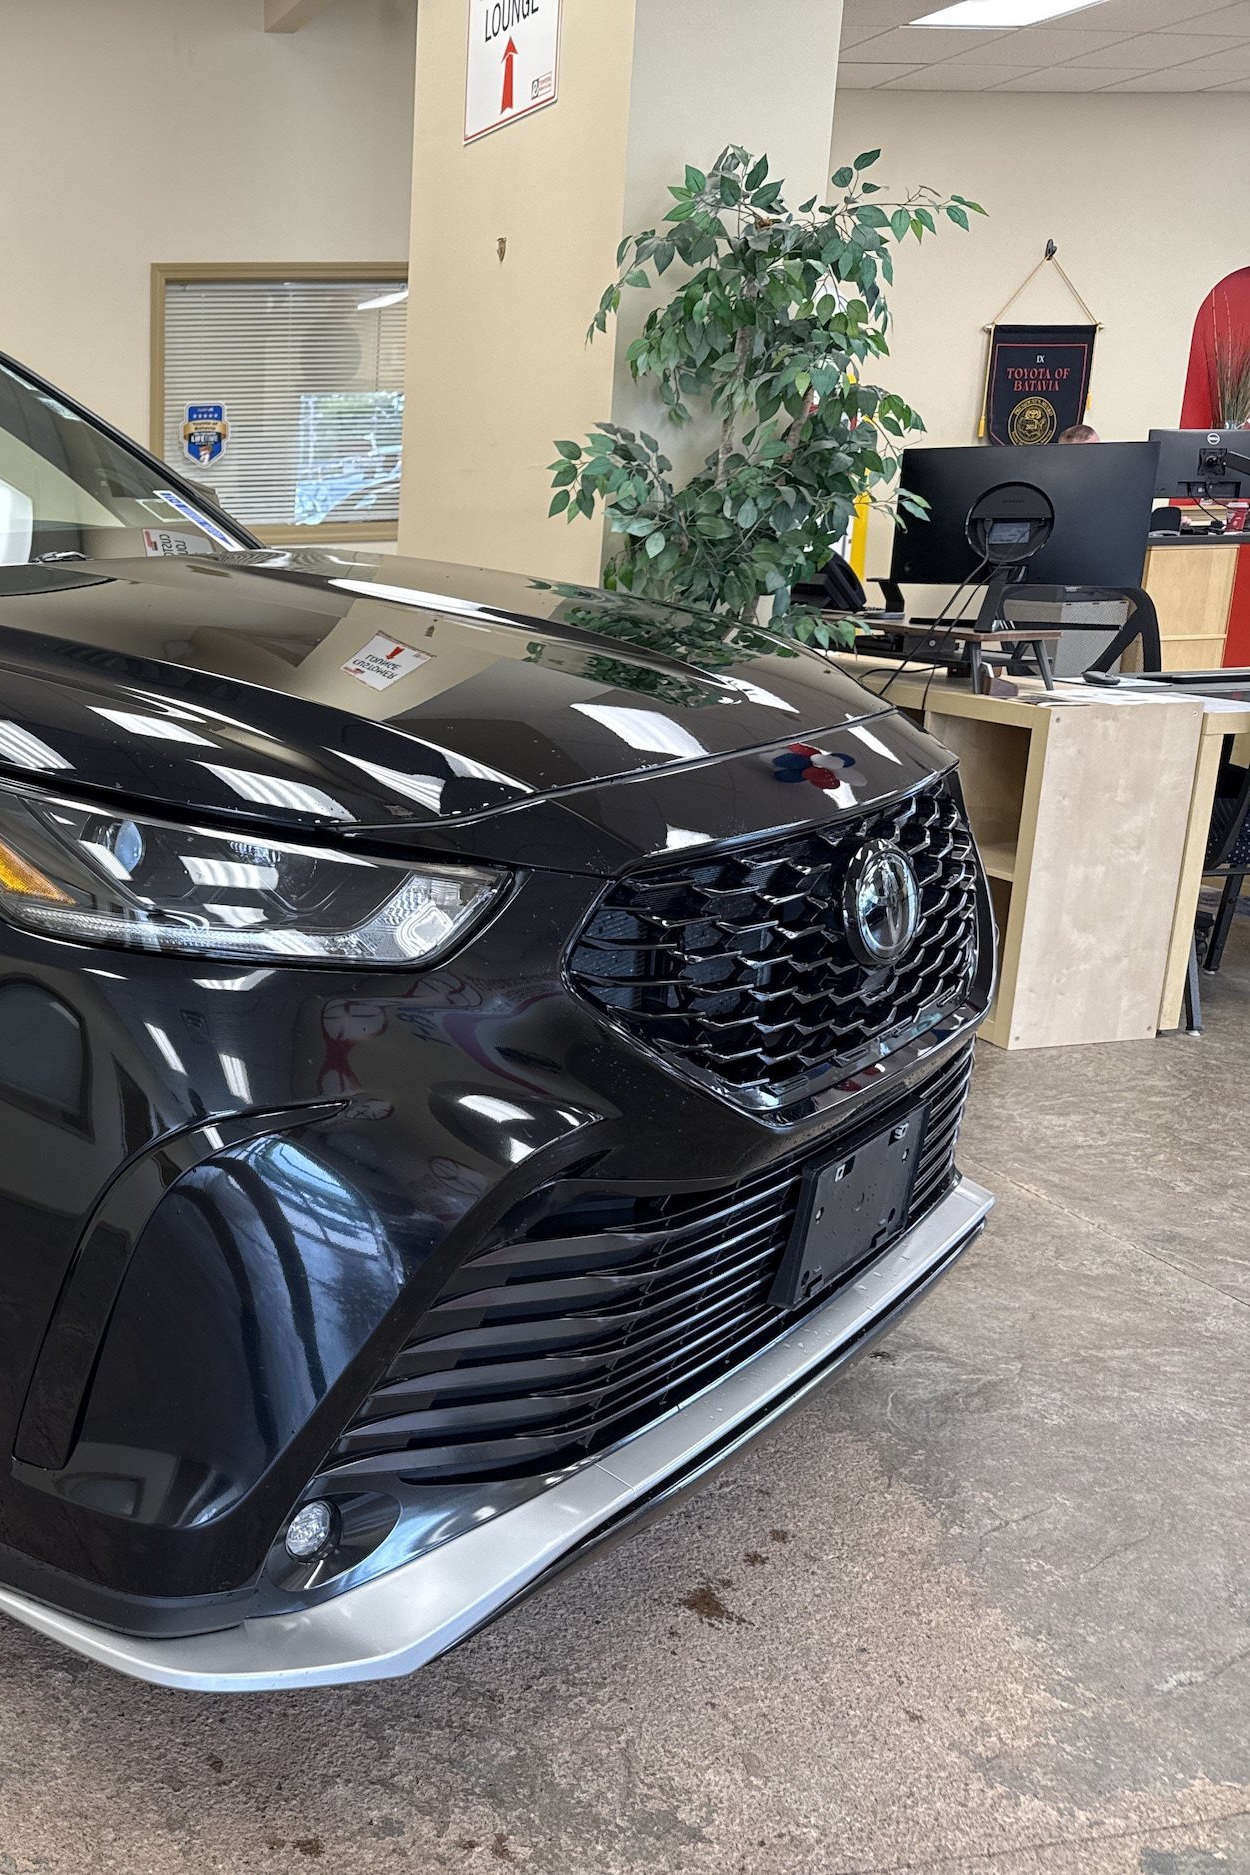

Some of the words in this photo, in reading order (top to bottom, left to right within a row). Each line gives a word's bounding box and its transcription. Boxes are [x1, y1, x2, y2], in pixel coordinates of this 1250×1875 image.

[1036, 355, 1045, 363] IX
[1007, 368, 1051, 379] TOYOTA
[1055, 368, 1070, 379] OF
[1013, 381, 1059, 391] BATAVIA
